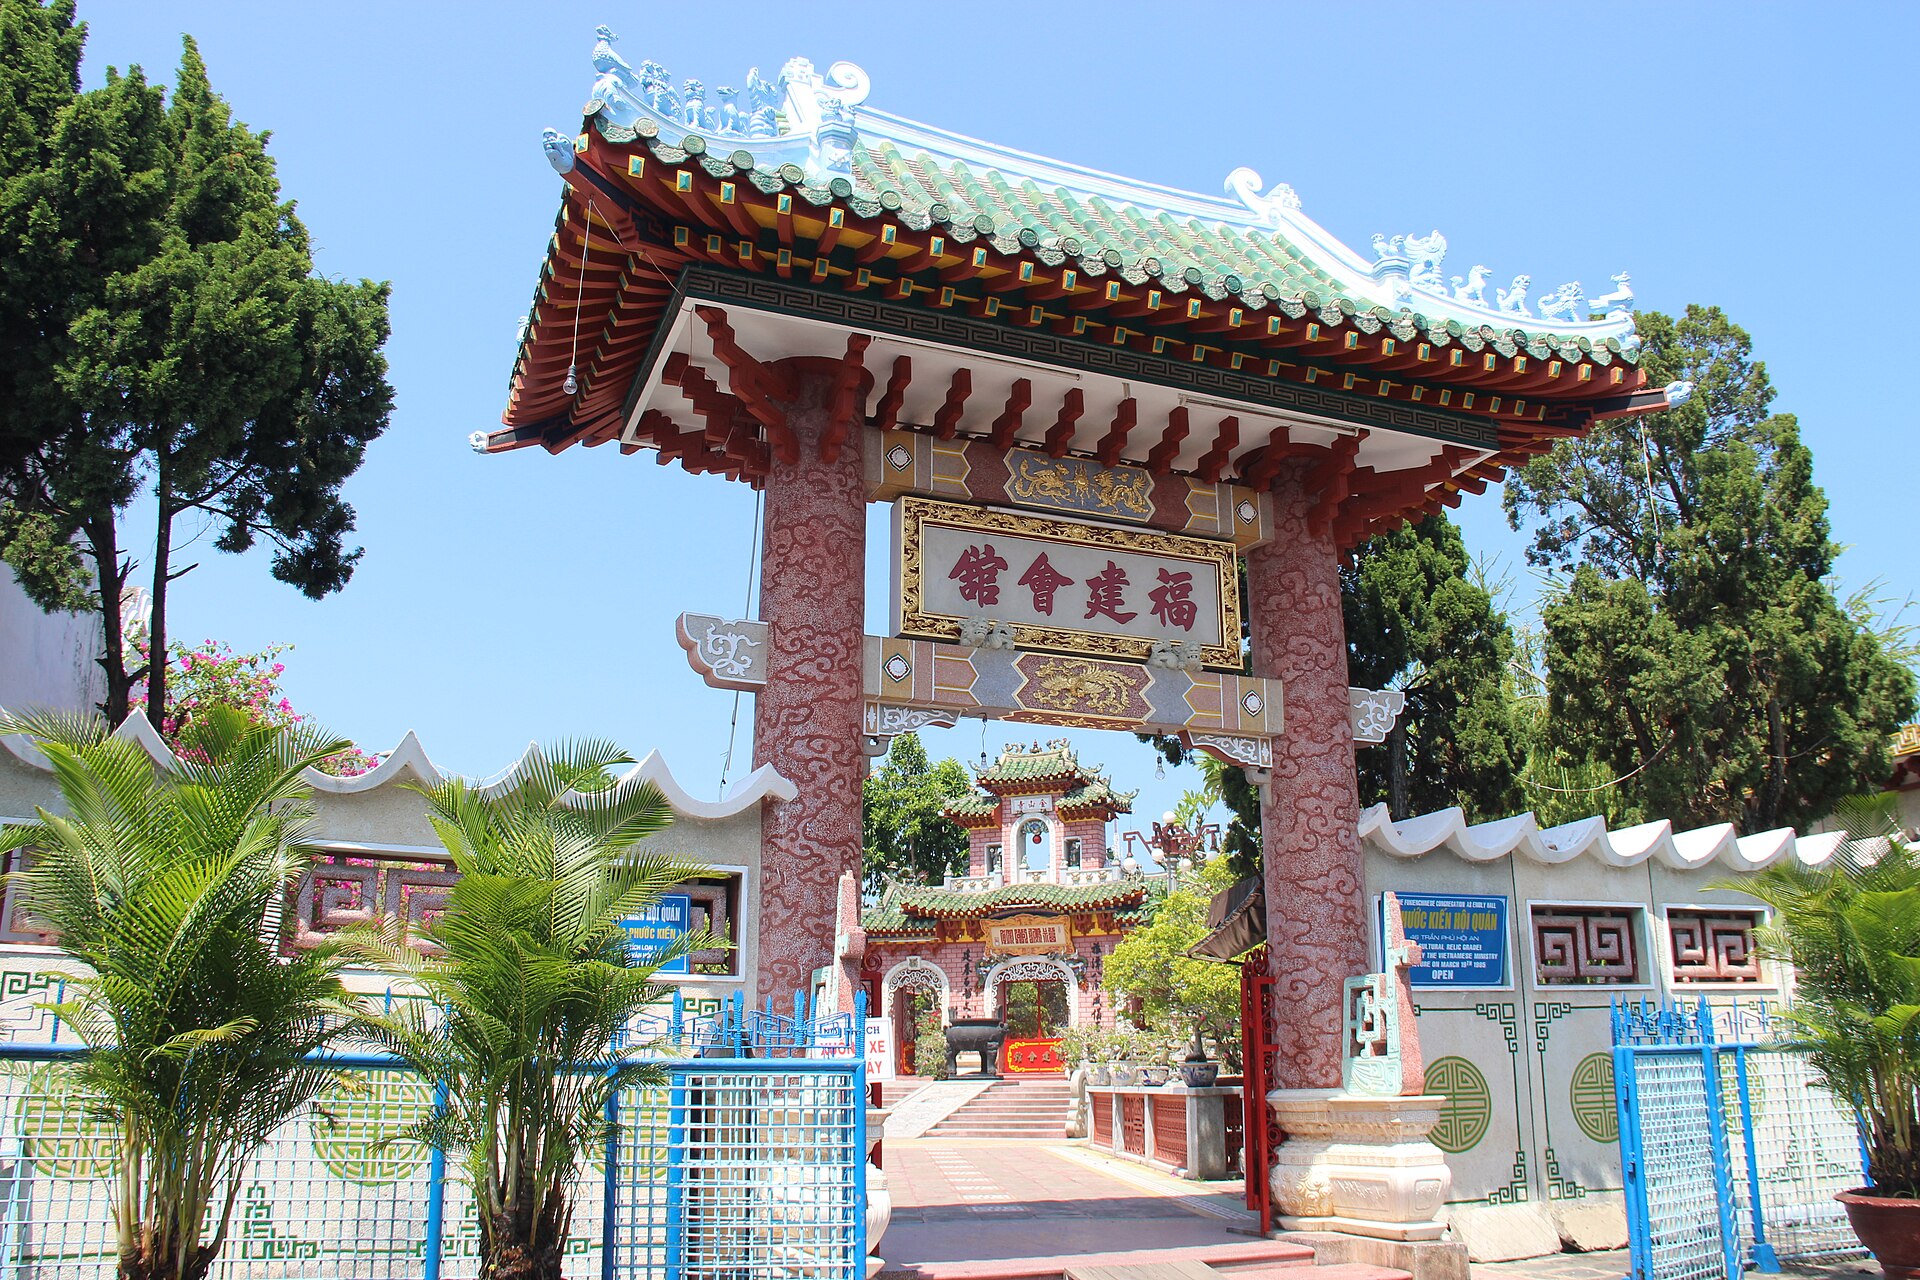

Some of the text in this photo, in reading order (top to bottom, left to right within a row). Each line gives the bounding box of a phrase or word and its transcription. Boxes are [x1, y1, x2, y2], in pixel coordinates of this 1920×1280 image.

[1429, 908, 1451, 929] KIẾN
[1454, 910, 1470, 933] HỘI
[1472, 910, 1497, 932] QUÁN
[629, 925, 655, 939] PHƯỚC
[657, 926, 676, 939] KIẾN
[1432, 970, 1454, 979] OPEN
[869, 1040, 885, 1053] XE
[866, 1058, 882, 1074] ÁY
